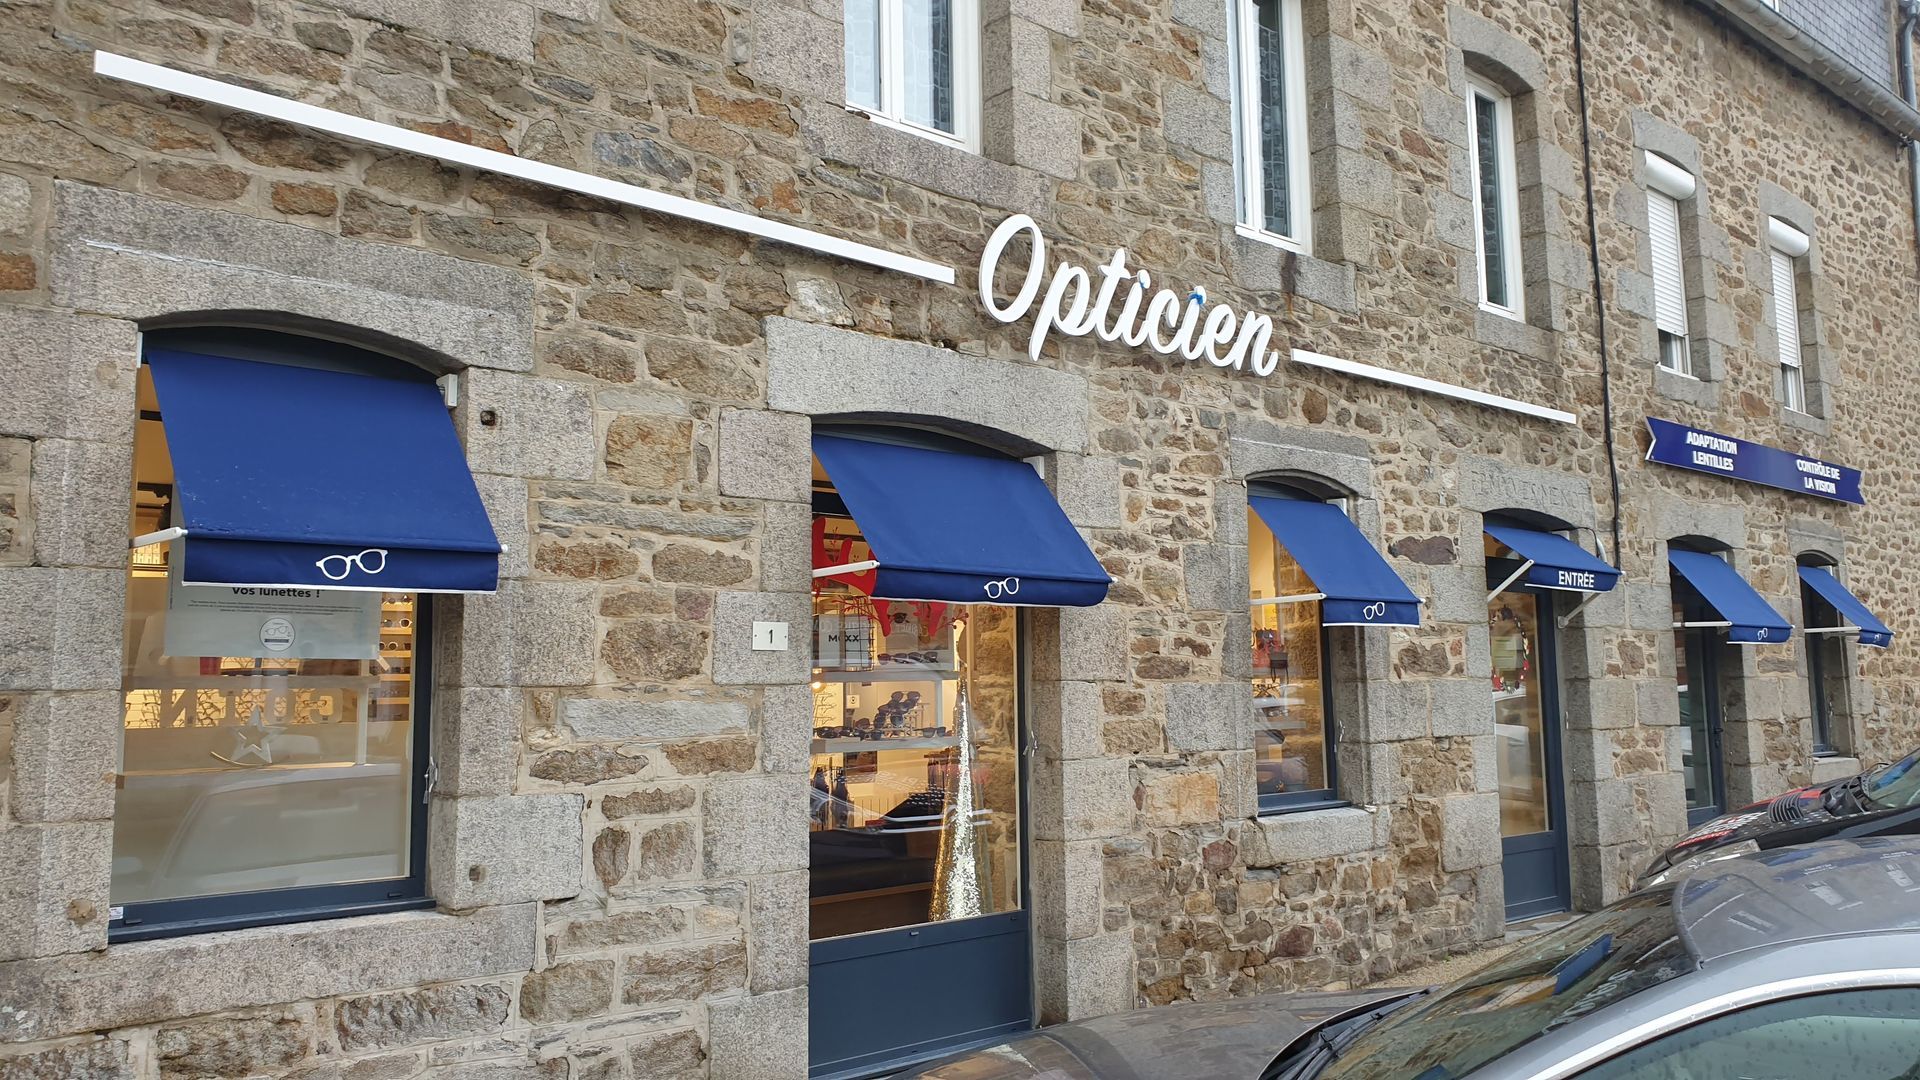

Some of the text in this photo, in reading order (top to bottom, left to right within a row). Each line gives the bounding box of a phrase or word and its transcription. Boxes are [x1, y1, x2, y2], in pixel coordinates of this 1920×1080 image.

[978, 213, 1278, 377] Opticien
[1686, 431, 1738, 455] ADAPTATION
[1692, 450, 1734, 471] LENTILLES
[1796, 459, 1841, 480] CONTRÔLE DE
[1804, 476, 1837, 494] LA VISION
[1558, 570, 1595, 588] ENTRÉE
[259, 587, 311, 598] lunettes
[768, 629, 774, 644] 1
[828, 634, 859, 643] MXX
